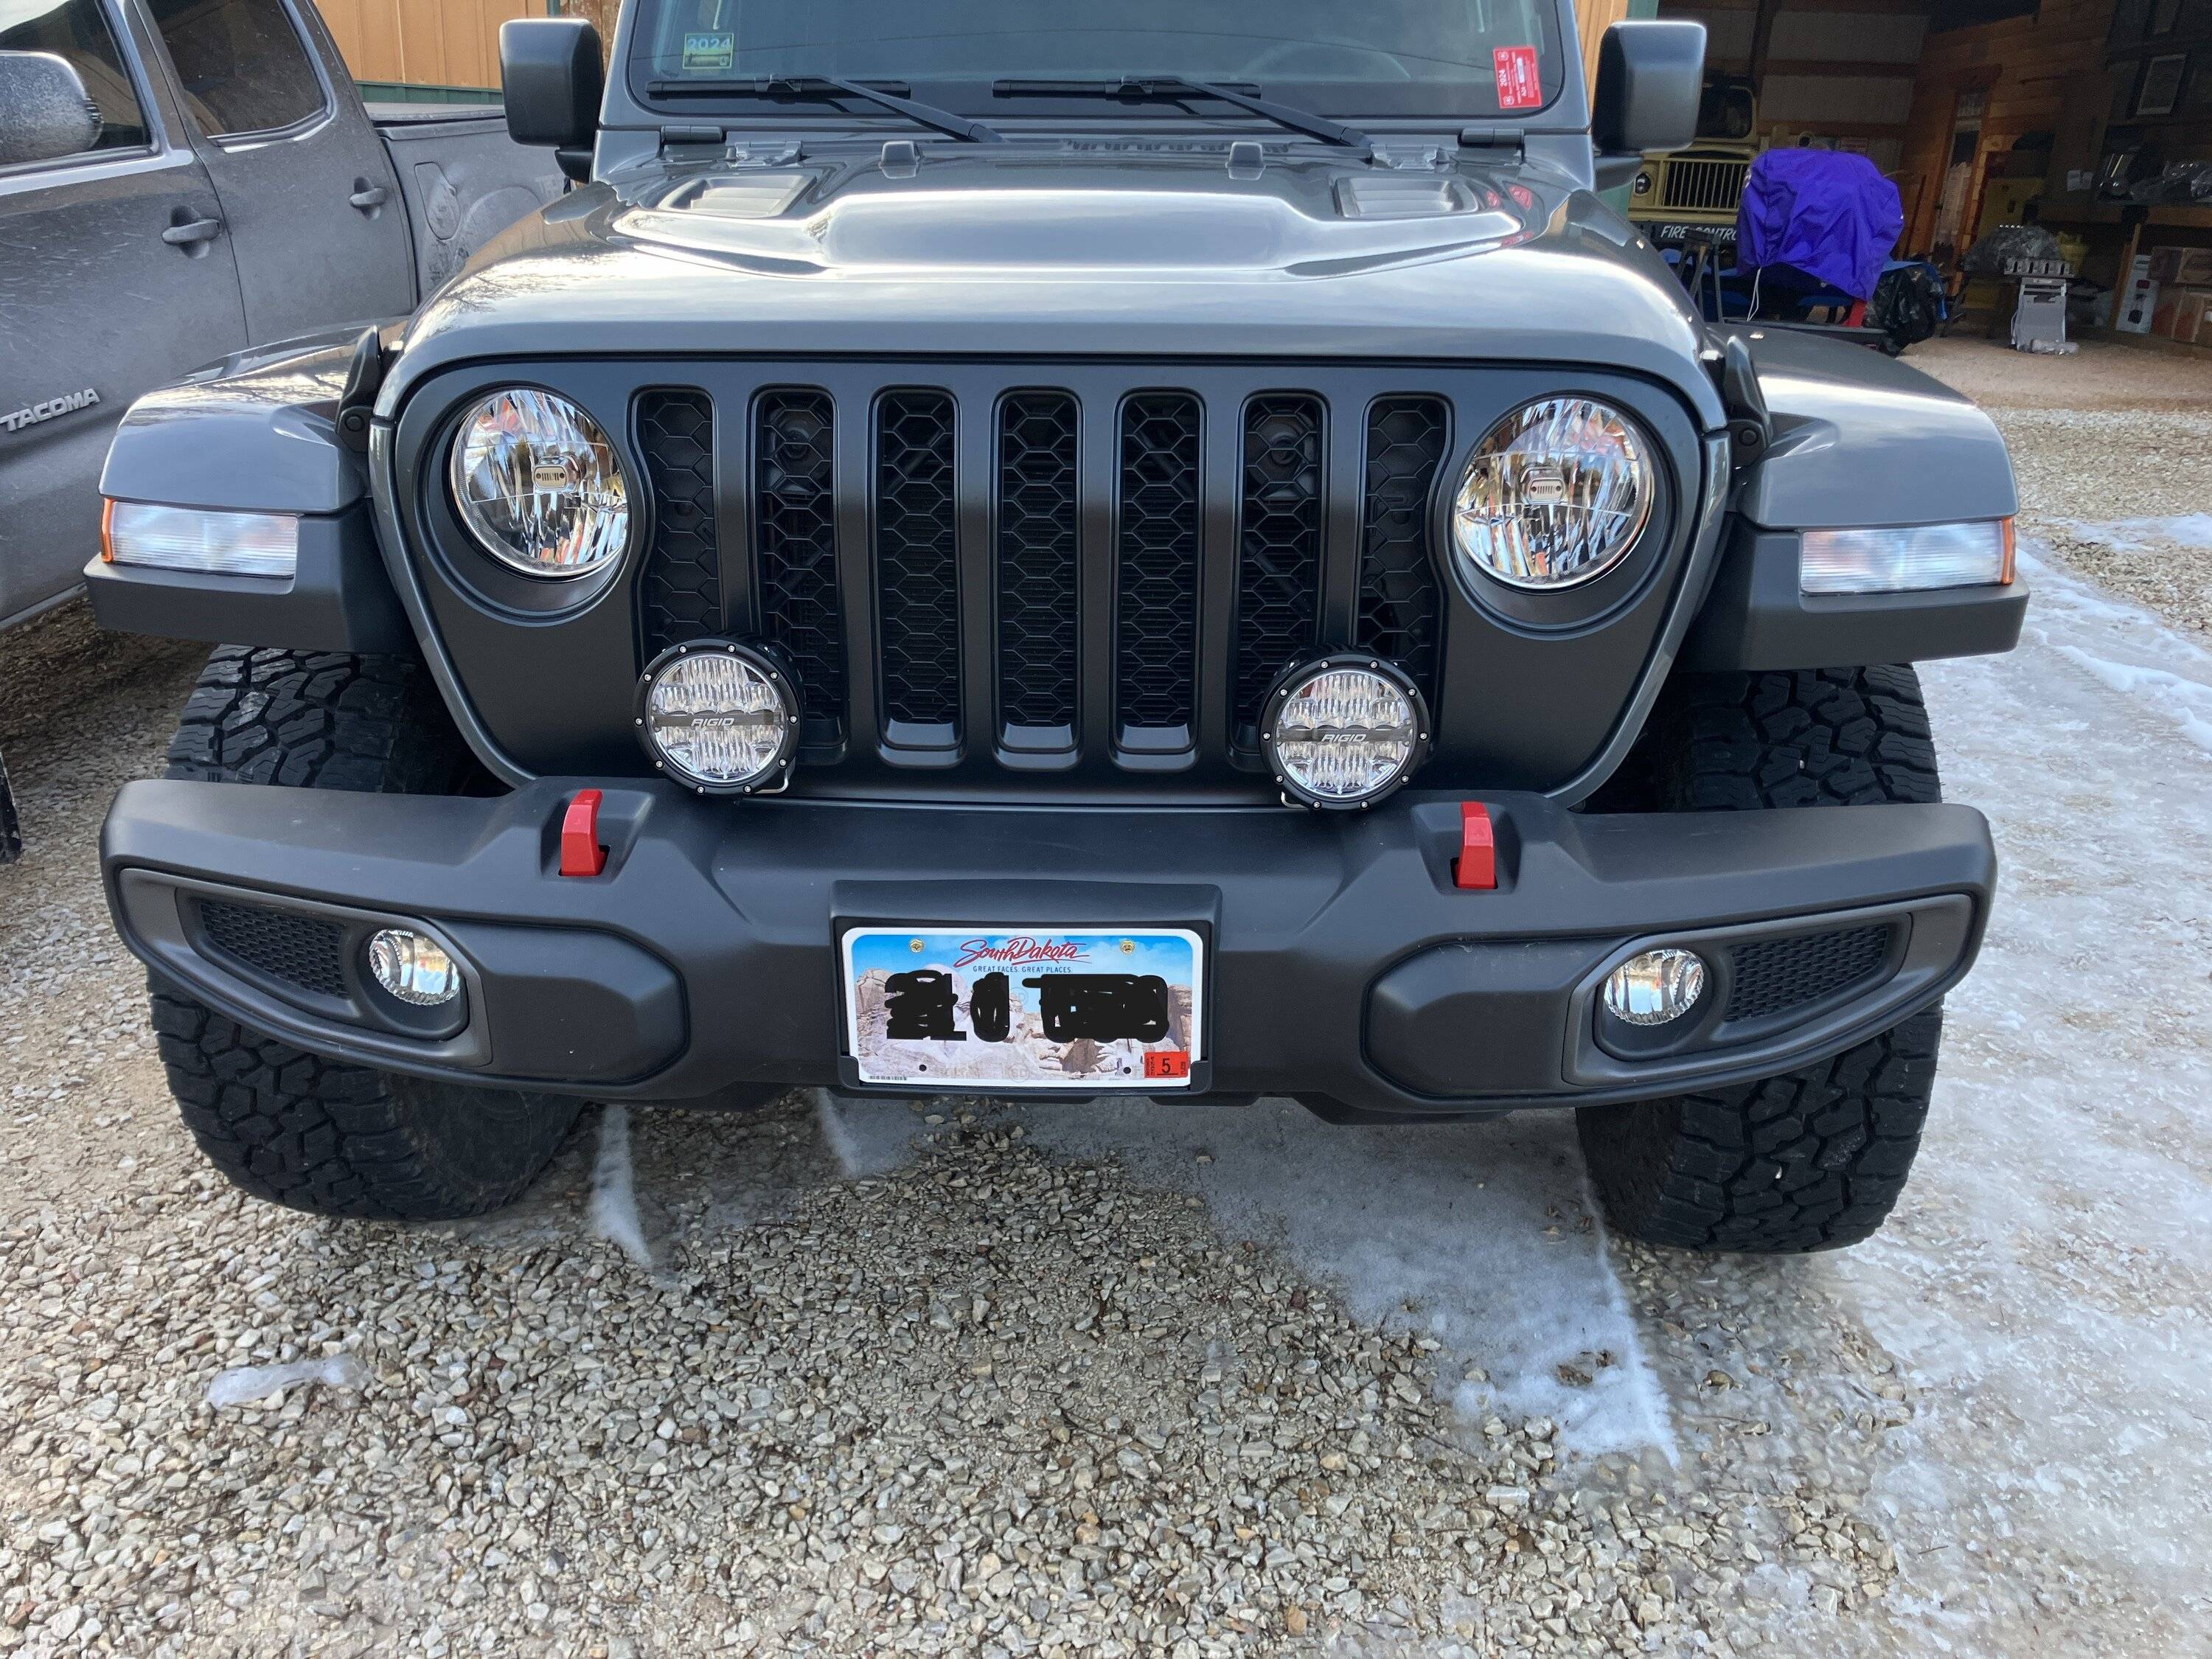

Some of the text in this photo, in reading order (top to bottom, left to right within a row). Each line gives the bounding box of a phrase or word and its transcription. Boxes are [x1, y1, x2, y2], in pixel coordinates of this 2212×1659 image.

[687, 38, 730, 50] 2024
[1498, 69, 1507, 87] 2024
[1660, 226, 1689, 239] FIRE
[0, 388, 100, 432] TACOMA
[691, 717, 734, 726] RIGID
[1321, 734, 1366, 742] RIGID
[953, 936, 1092, 968] South Dakota
[1161, 1057, 1171, 1074] 5
